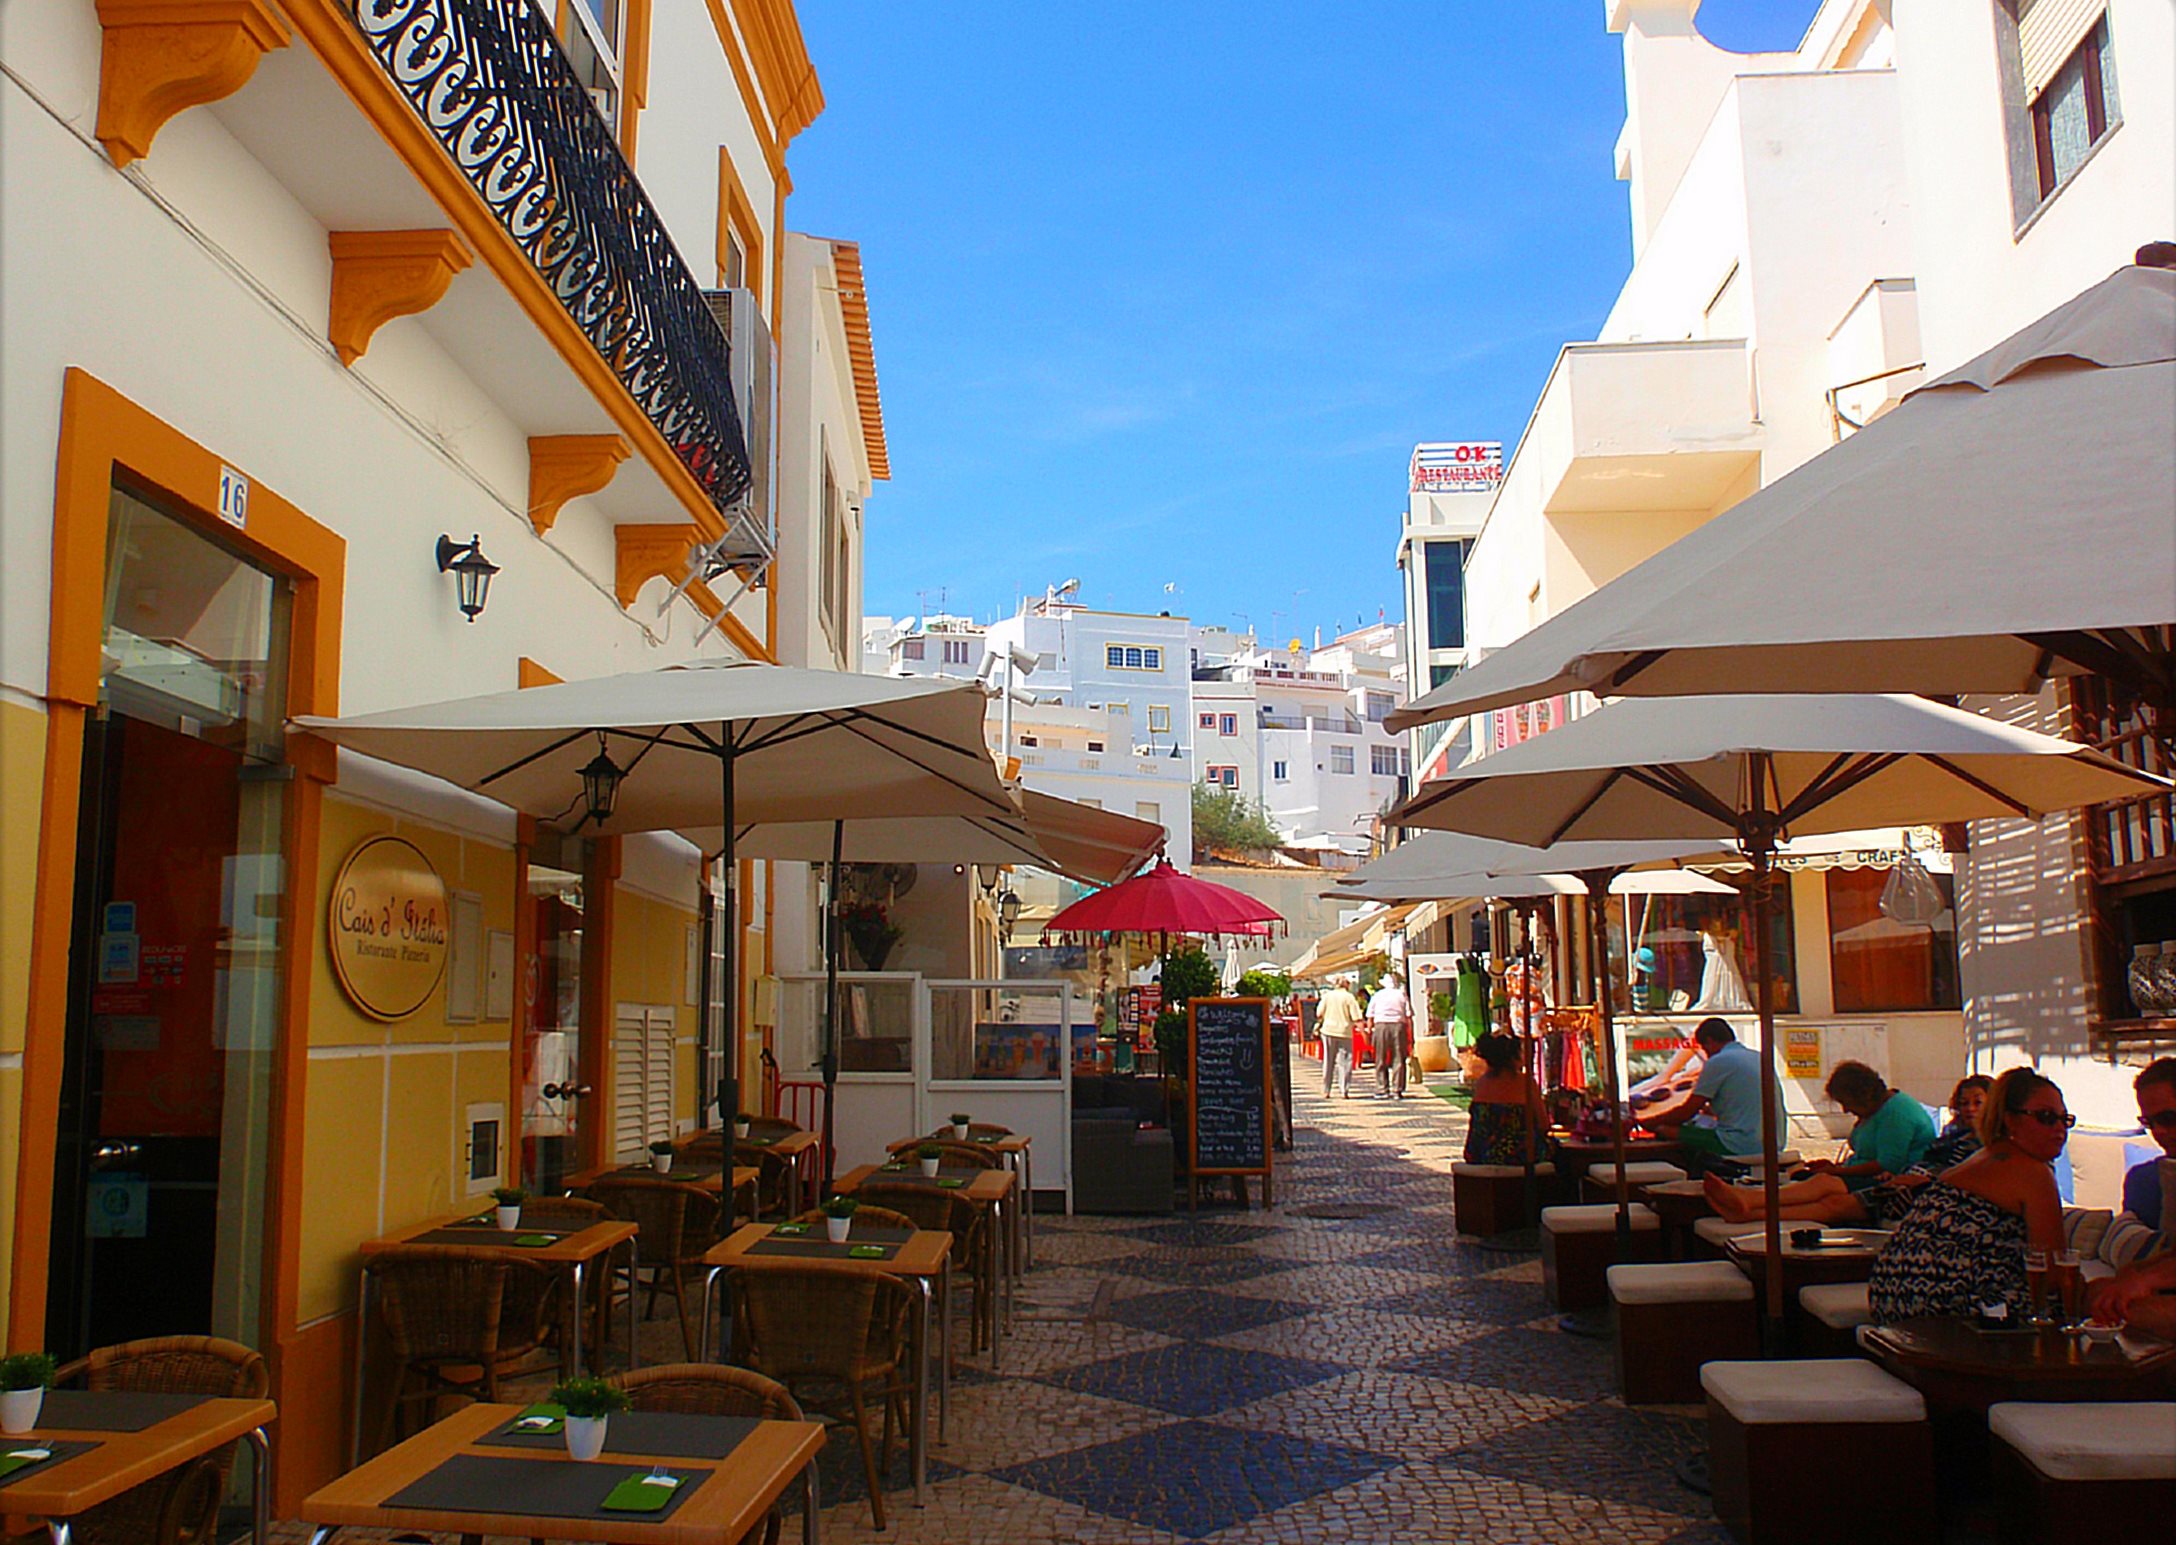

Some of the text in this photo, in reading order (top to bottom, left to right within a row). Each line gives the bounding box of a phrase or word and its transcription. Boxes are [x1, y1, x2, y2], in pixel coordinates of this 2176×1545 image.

[1455, 445, 1488, 462] OK
[1417, 464, 1502, 482] RESTAURANTE
[222, 476, 245, 519] 16
[340, 887, 374, 936] Cais
[357, 939, 430, 963] Ristorante Pizzeria
